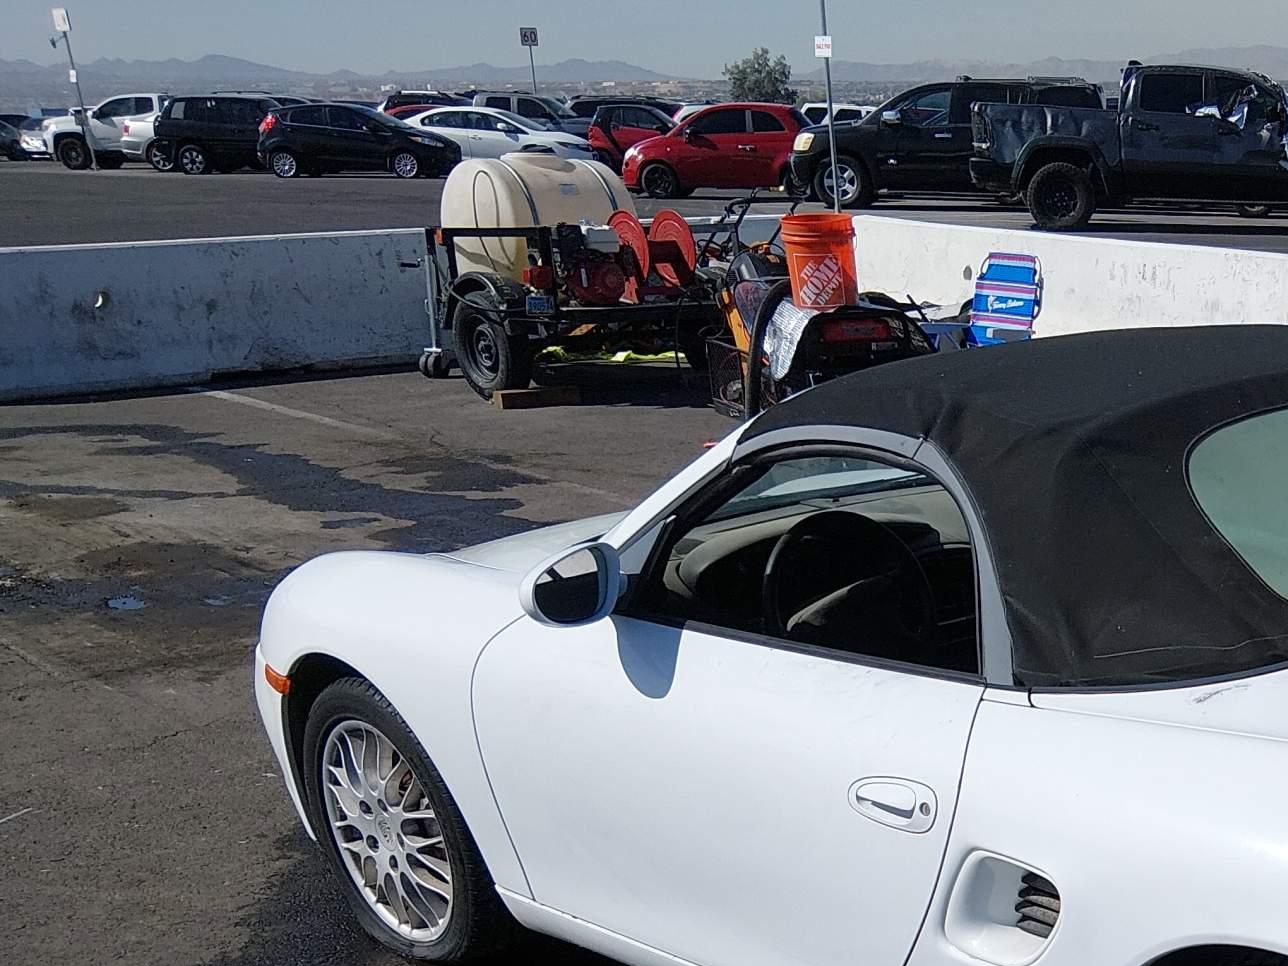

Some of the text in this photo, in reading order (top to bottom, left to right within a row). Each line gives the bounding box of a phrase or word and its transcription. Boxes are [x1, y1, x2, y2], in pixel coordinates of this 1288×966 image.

[523, 31, 537, 43] 60
[800, 255, 840, 306] HOME
[816, 270, 843, 306] DEPOT
